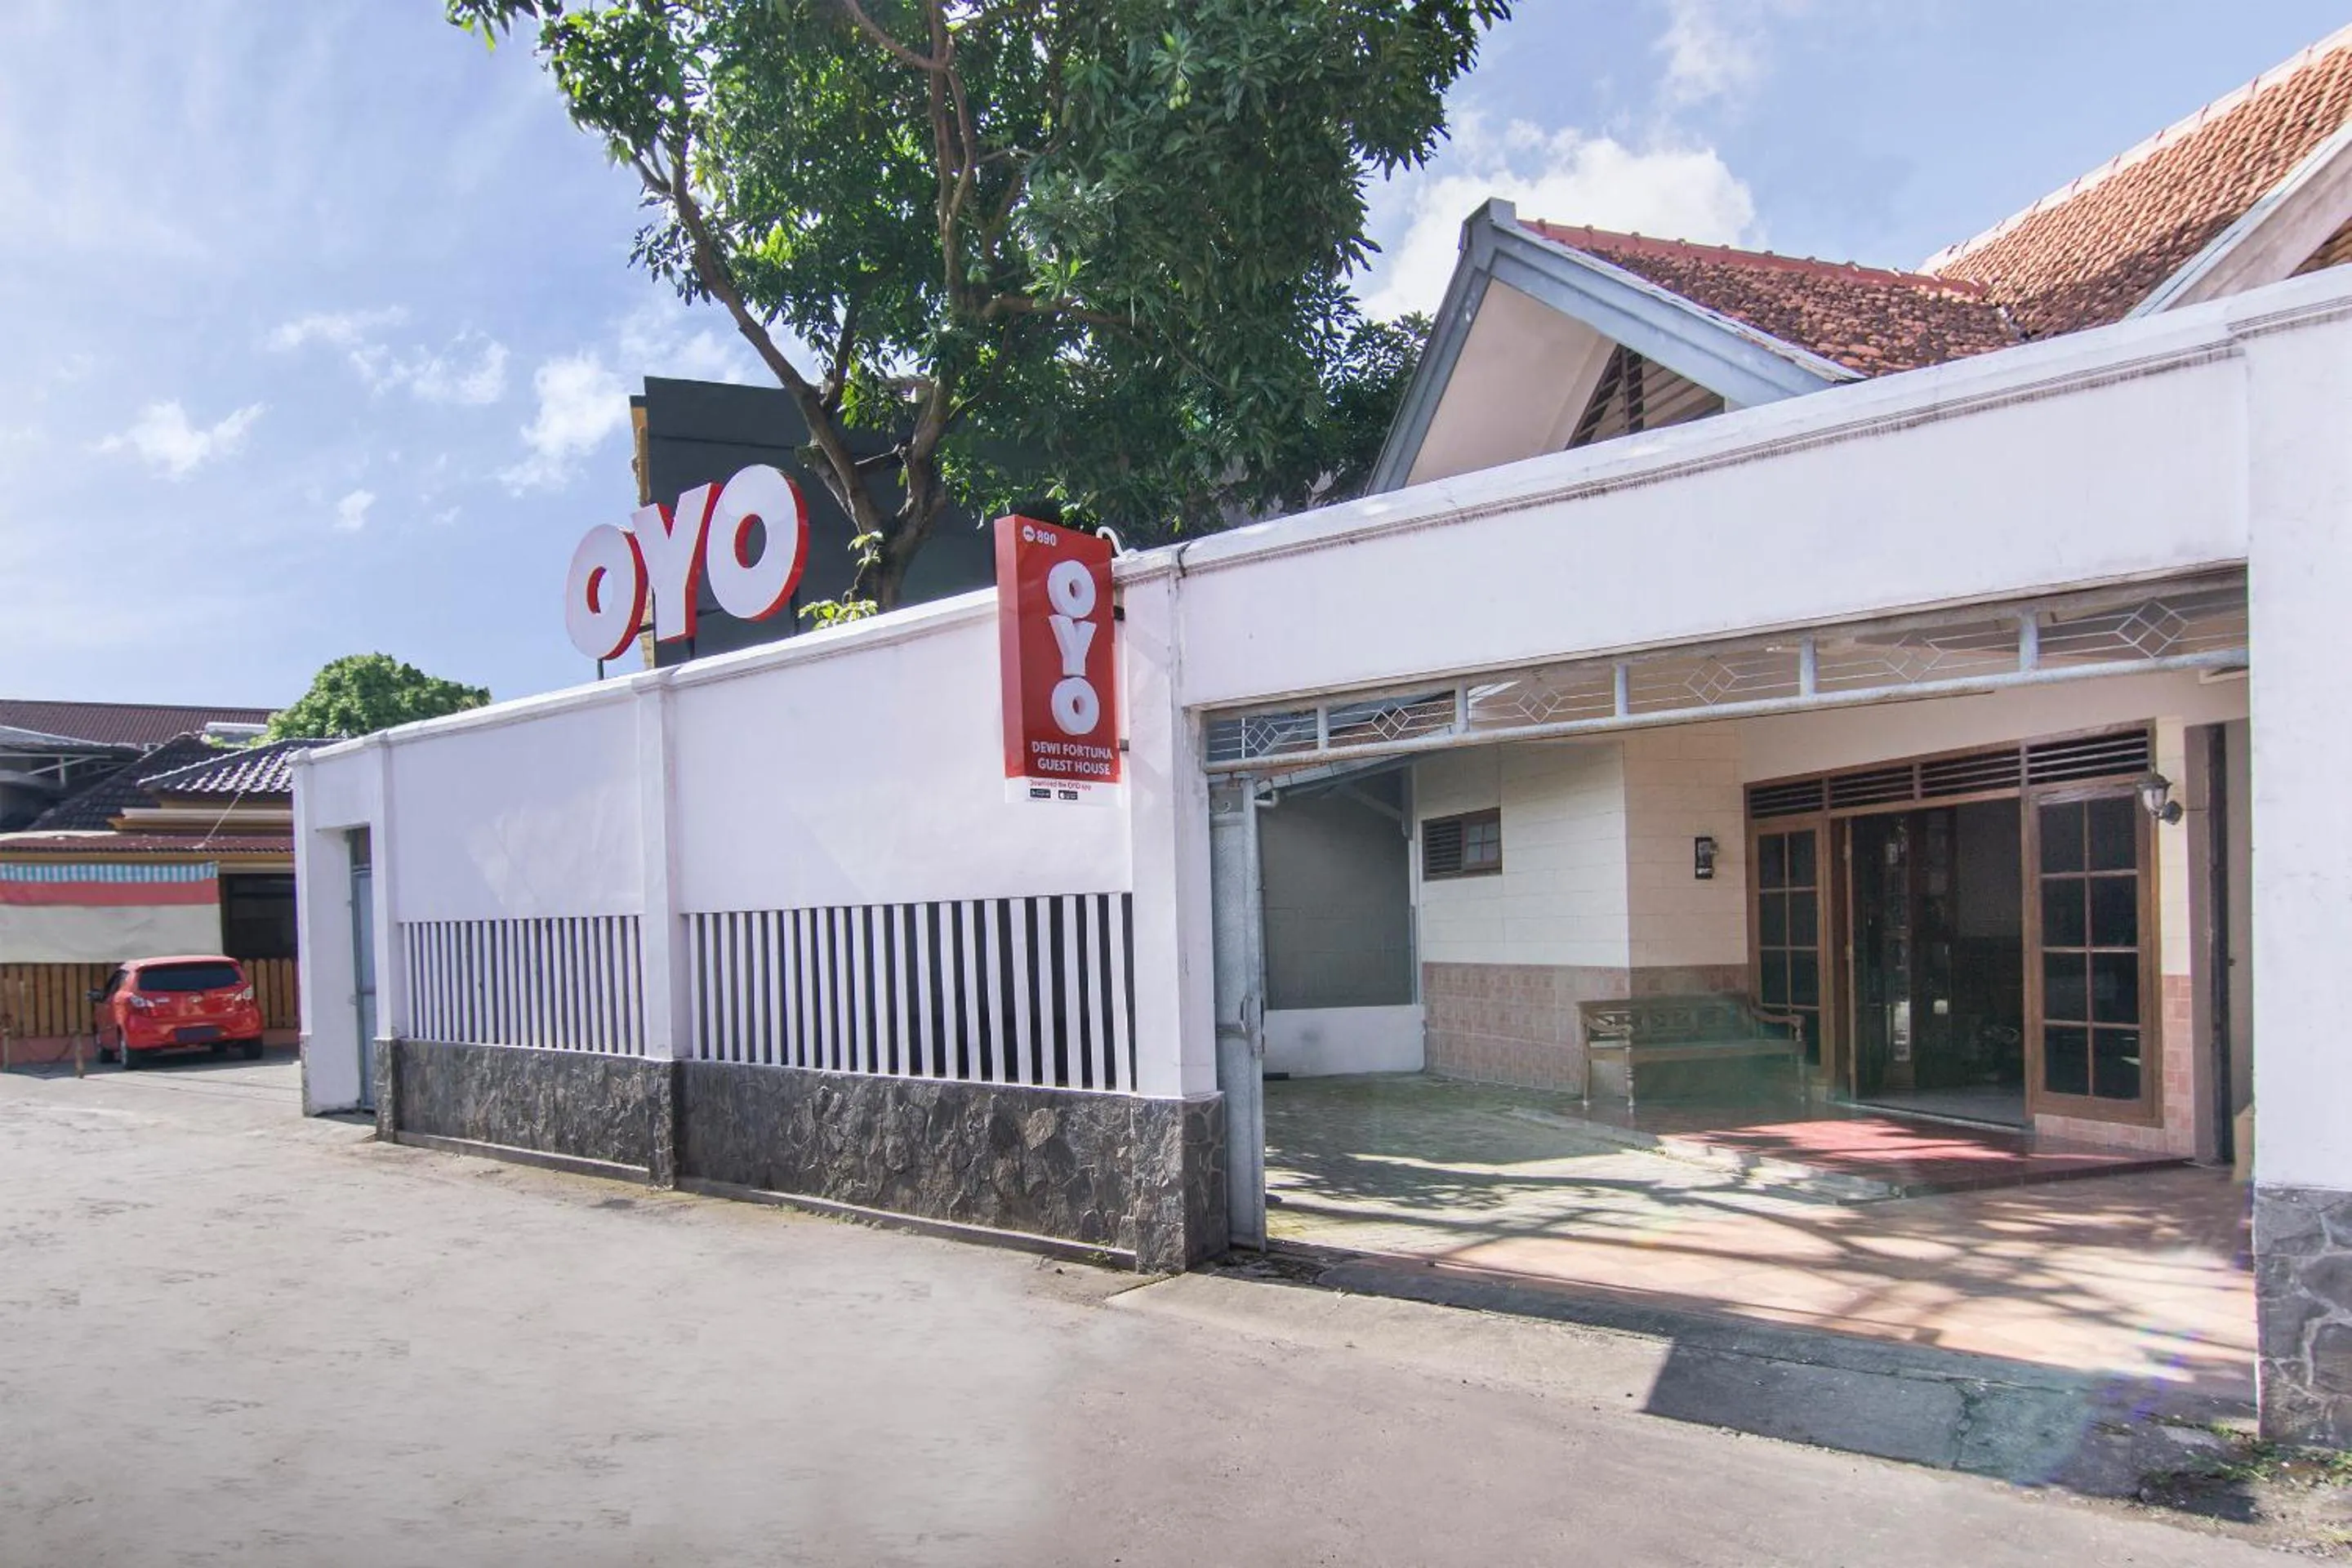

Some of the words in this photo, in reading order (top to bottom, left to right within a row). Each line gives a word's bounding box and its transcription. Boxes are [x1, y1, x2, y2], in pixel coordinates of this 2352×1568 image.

[1036, 529, 1057, 546] 890
[565, 464, 809, 661] OYO
[1047, 559, 1100, 736] OYO
[1031, 741, 1061, 754] DEWI
[1062, 744, 1113, 760] FORTUNA
[1037, 759, 1072, 772] GUEST
[1074, 762, 1111, 775] HOUSE
